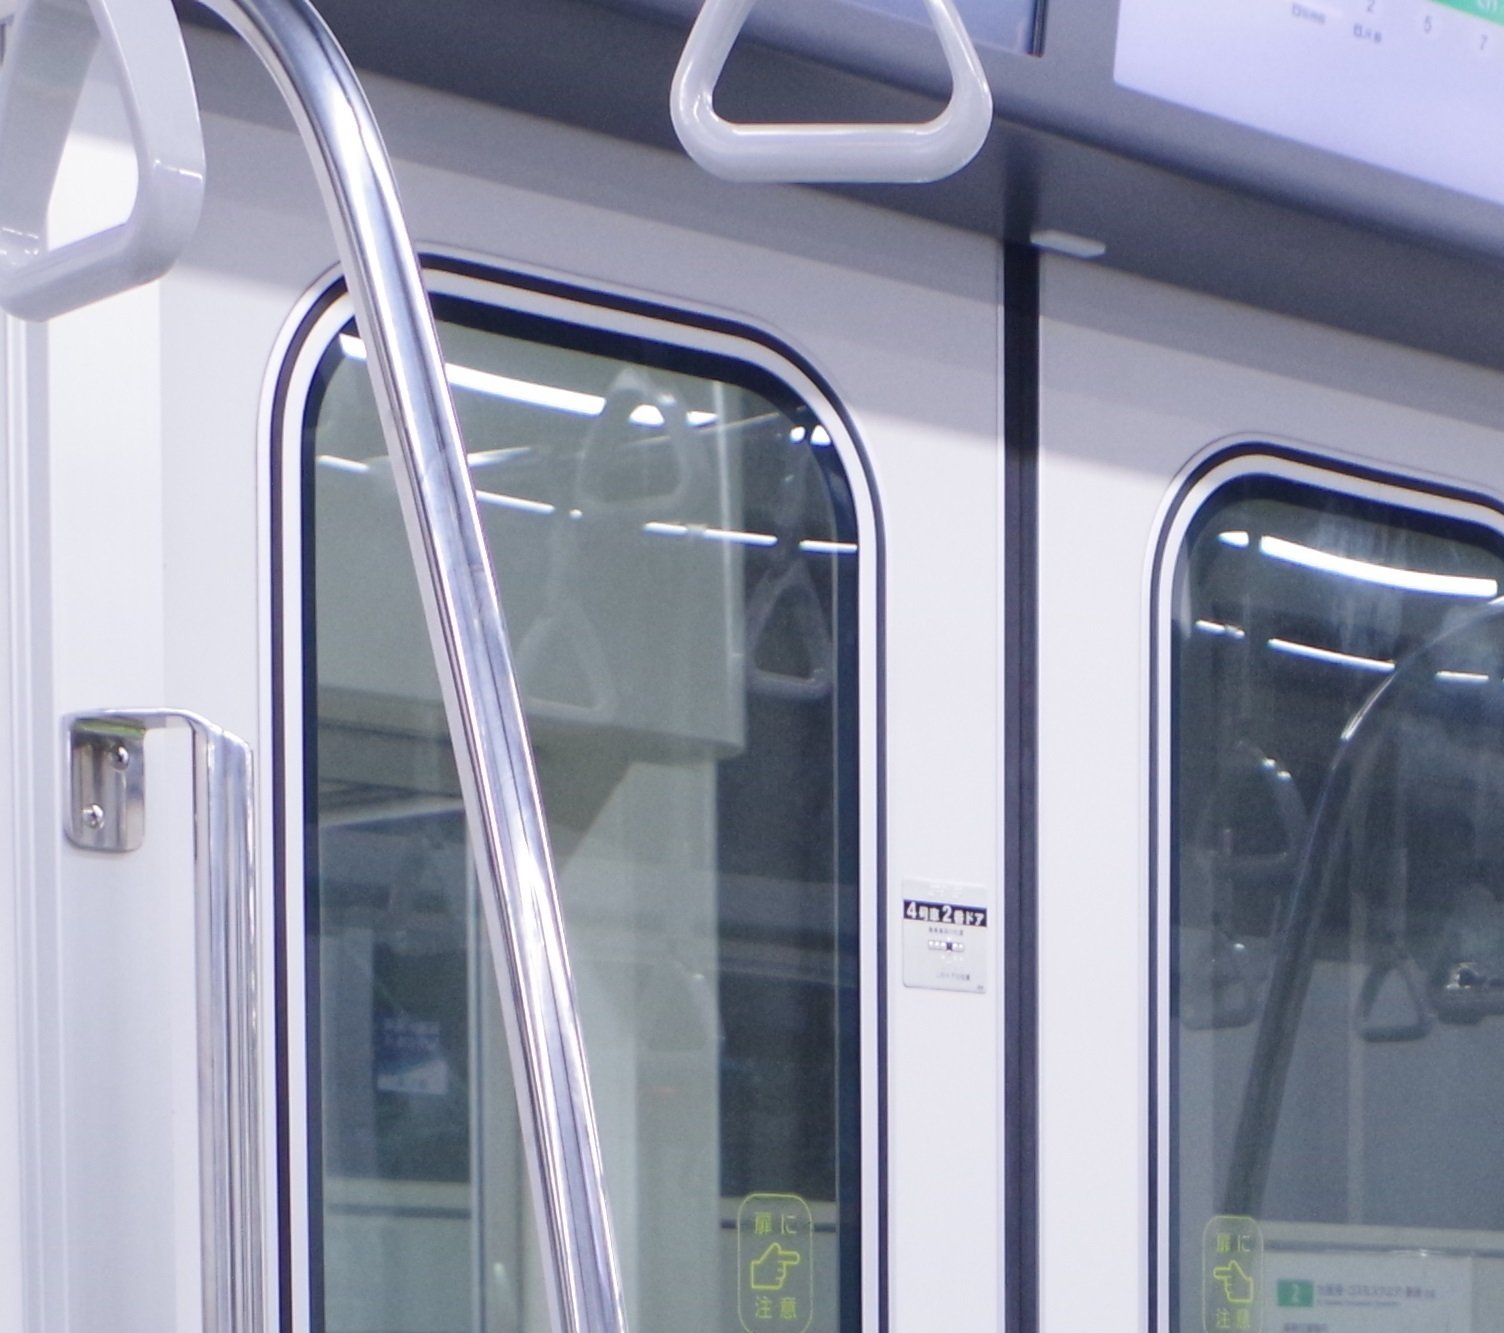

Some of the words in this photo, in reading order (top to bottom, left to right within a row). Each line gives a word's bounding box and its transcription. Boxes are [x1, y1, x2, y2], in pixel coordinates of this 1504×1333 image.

[1422, 15, 1433, 34] 5
[1479, 33, 1489, 51] 7
[754, 1295, 798, 1320] 注意
